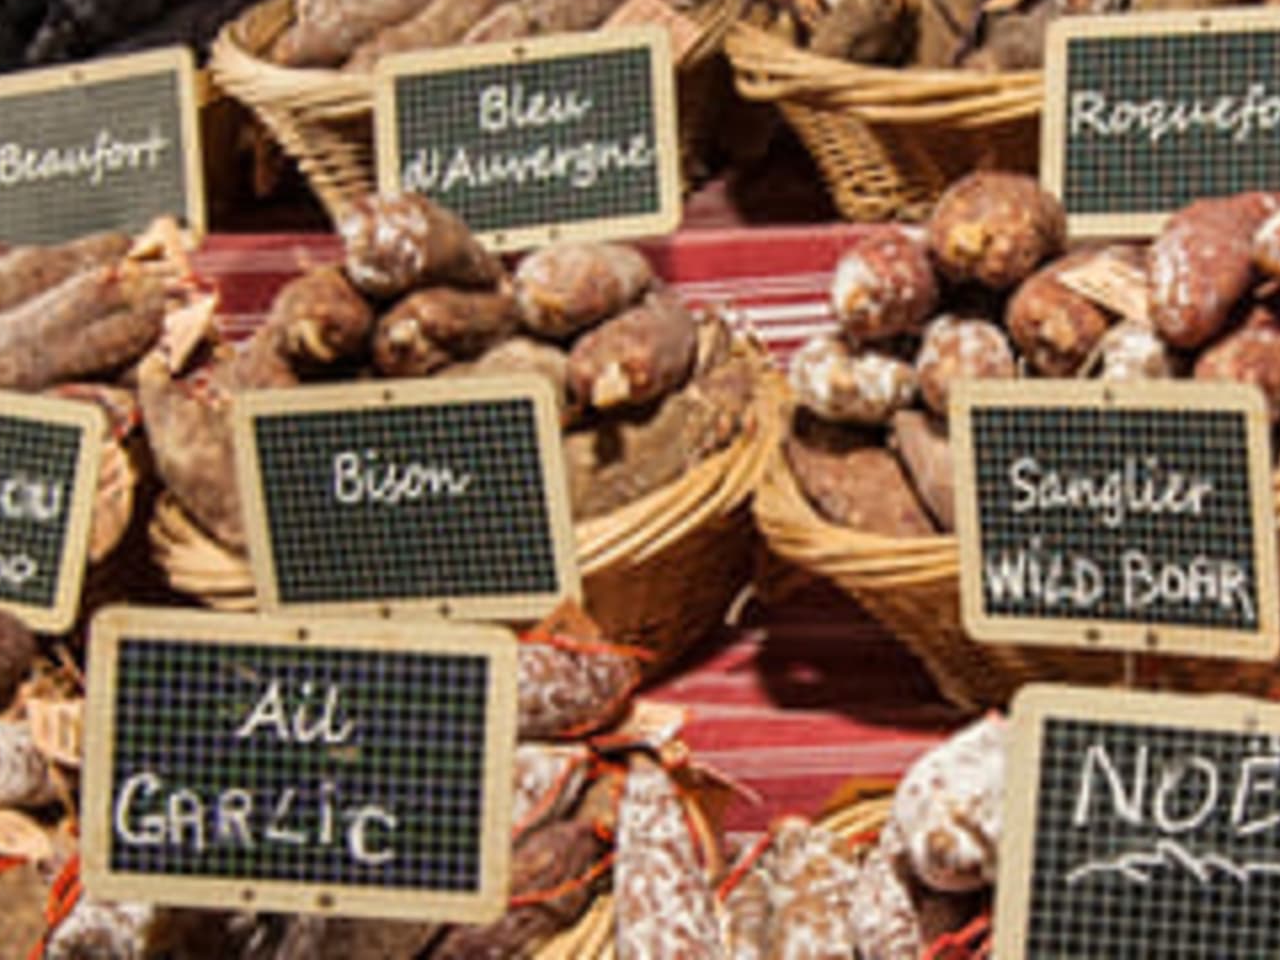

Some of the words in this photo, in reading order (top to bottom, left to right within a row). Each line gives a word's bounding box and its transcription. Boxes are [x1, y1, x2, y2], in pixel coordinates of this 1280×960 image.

[478, 84, 590, 129] Bleu
[400, 132, 655, 196] d'Auvergne
[334, 451, 472, 507] Bison
[1010, 456, 1214, 528] Sanglier
[1121, 549, 1255, 622] BOAR
[239, 680, 356, 746] Ail
